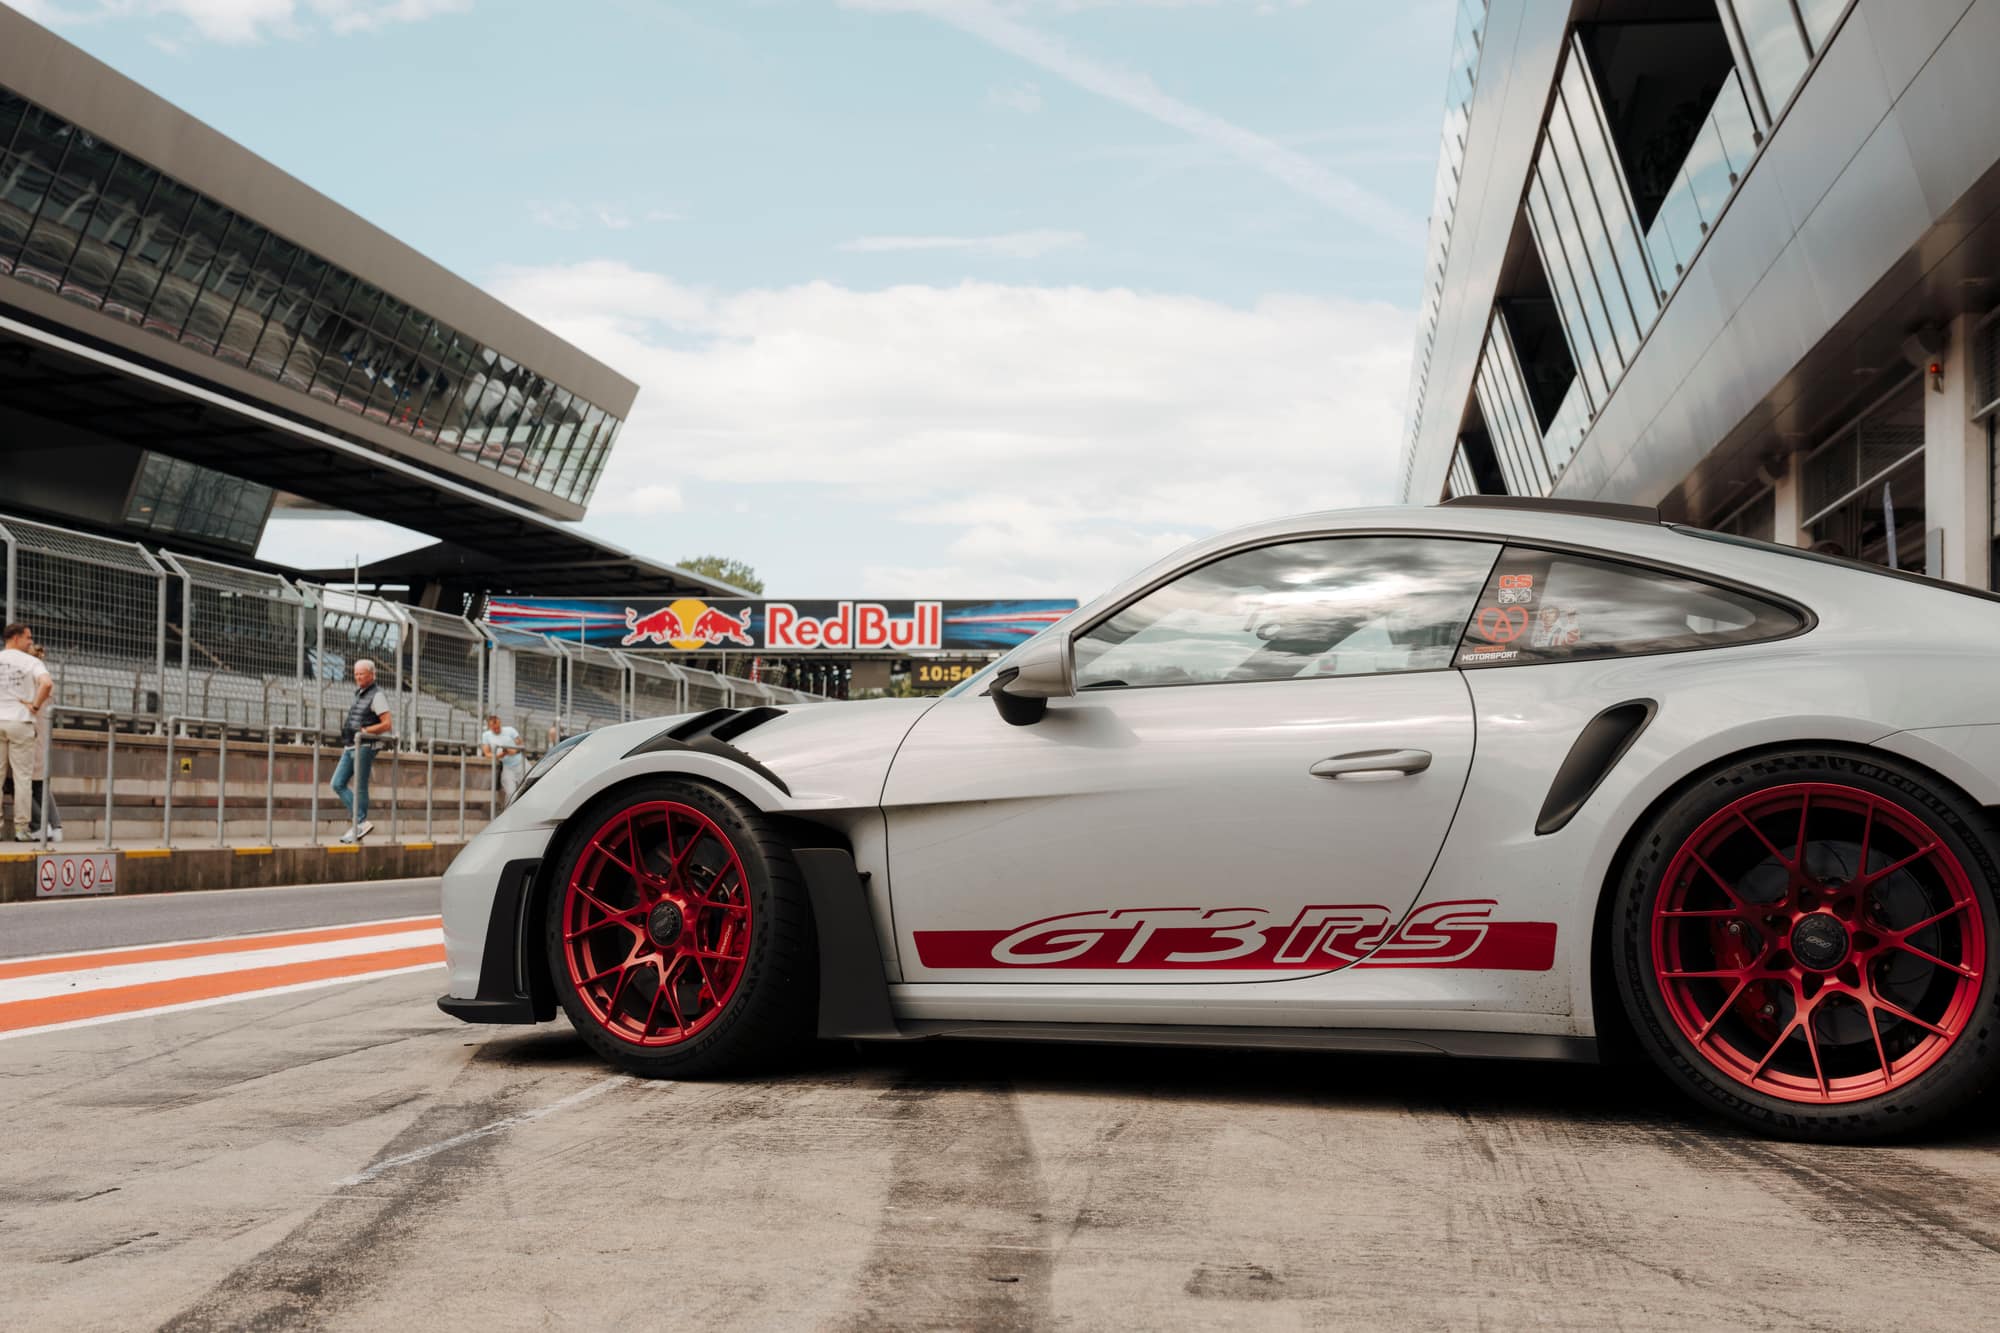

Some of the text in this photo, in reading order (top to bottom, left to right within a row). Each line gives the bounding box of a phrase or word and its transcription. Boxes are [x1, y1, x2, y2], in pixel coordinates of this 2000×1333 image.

[767, 603, 940, 647] Red Bull
[1462, 650, 1518, 661] MOTORSPORT
[1857, 762, 1960, 824] MICHELIN
[992, 899, 1499, 965] GT3 RS
